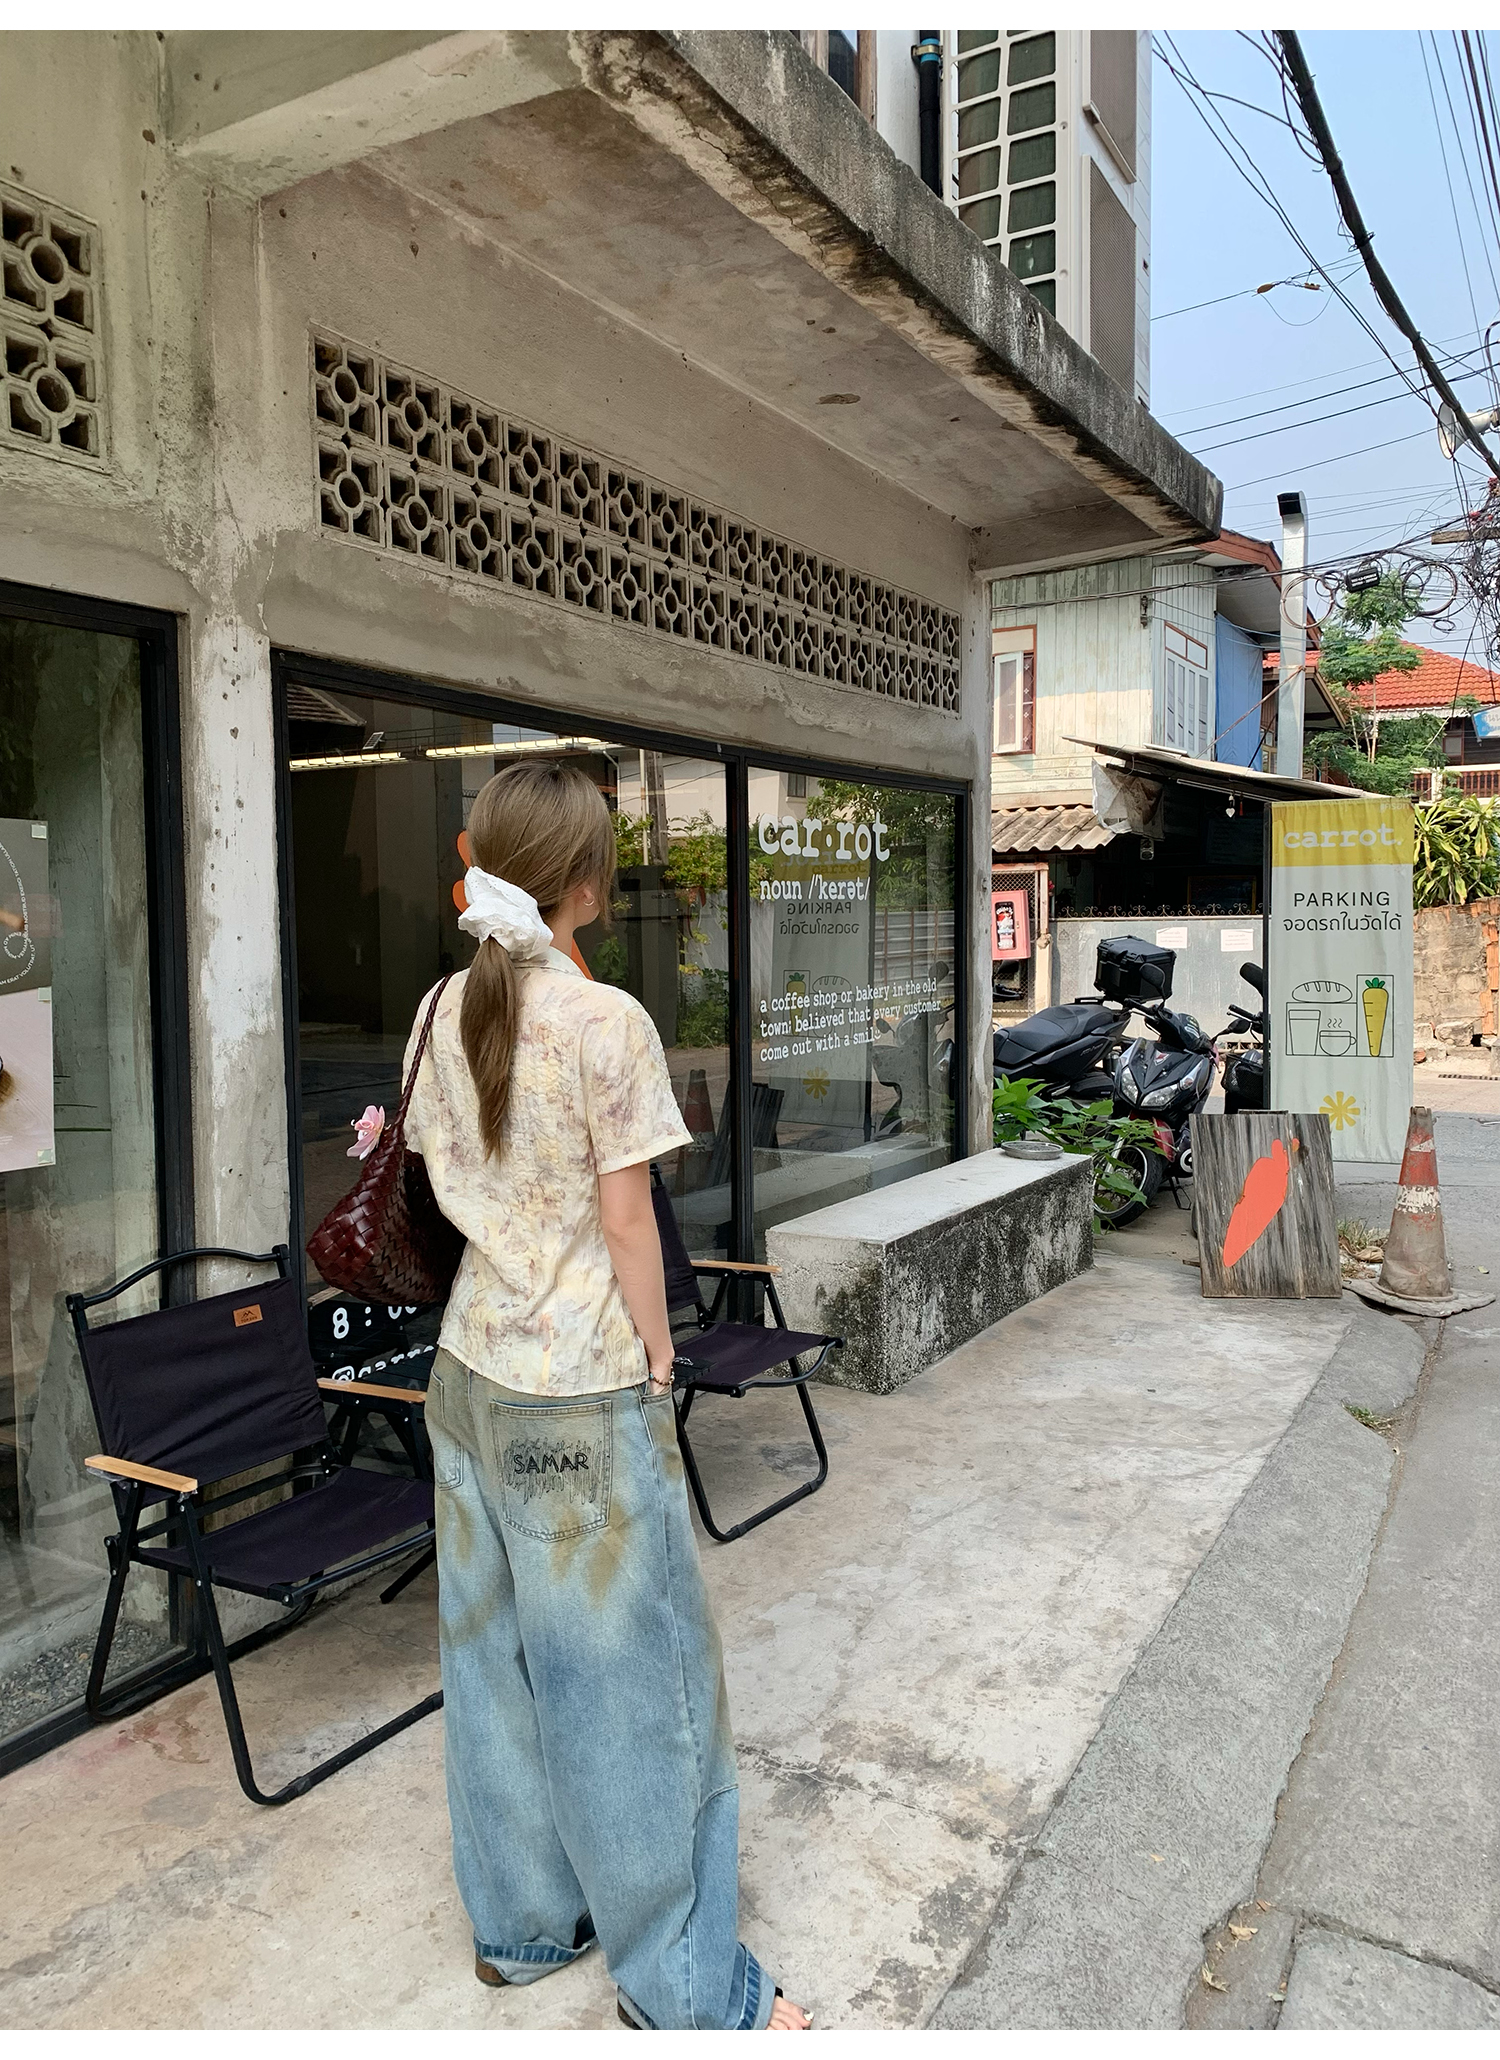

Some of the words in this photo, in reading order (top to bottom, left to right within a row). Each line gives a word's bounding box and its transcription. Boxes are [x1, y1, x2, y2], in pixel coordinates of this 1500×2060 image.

[1283, 823, 1403, 848] carrot.
[760, 880, 802, 900] noun
[1293, 891, 1390, 907] PARKING
[1283, 911, 1402, 931] จอดรถในวัดได้
[760, 1000, 768, 1013] a
[772, 992, 811, 1011] coffee
[813, 990, 838, 1009] shop
[841, 991, 853, 1003] or
[856, 985, 890, 1001] bakery
[893, 982, 903, 997] in
[906, 980, 921, 995] the
[923, 977, 937, 992] old
[795, 1010, 845, 1033] believed
[848, 1006, 871, 1023] that
[874, 1005, 901, 1020] every
[904, 999, 942, 1015] customer
[760, 1045, 789, 1061] come
[792, 1037, 812, 1056] out
[816, 1033, 840, 1051] with
[844, 1033, 850, 1047] a
[513, 1451, 589, 1474] SAMAR
